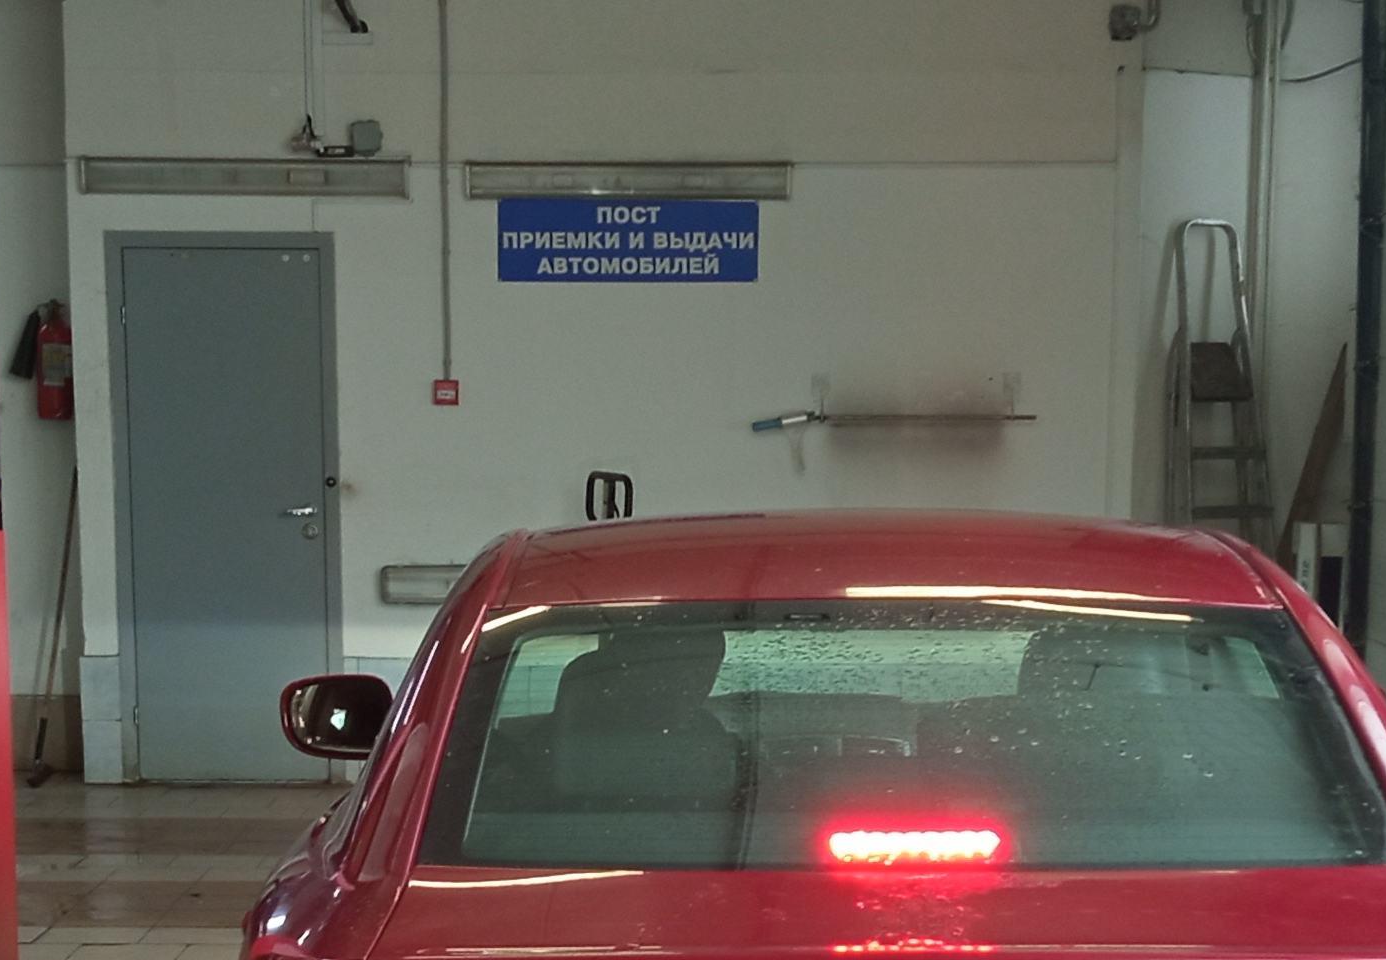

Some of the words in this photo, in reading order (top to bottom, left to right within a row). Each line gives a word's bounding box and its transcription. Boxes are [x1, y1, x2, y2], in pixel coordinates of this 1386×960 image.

[596, 206, 661, 224] ПОСТ
[502, 231, 620, 249] ПРИЕМКИ
[629, 231, 645, 249] И
[653, 231, 755, 253] ВЫДАЧИ
[537, 253, 720, 274] АВТОМОБИЛЕЙ
